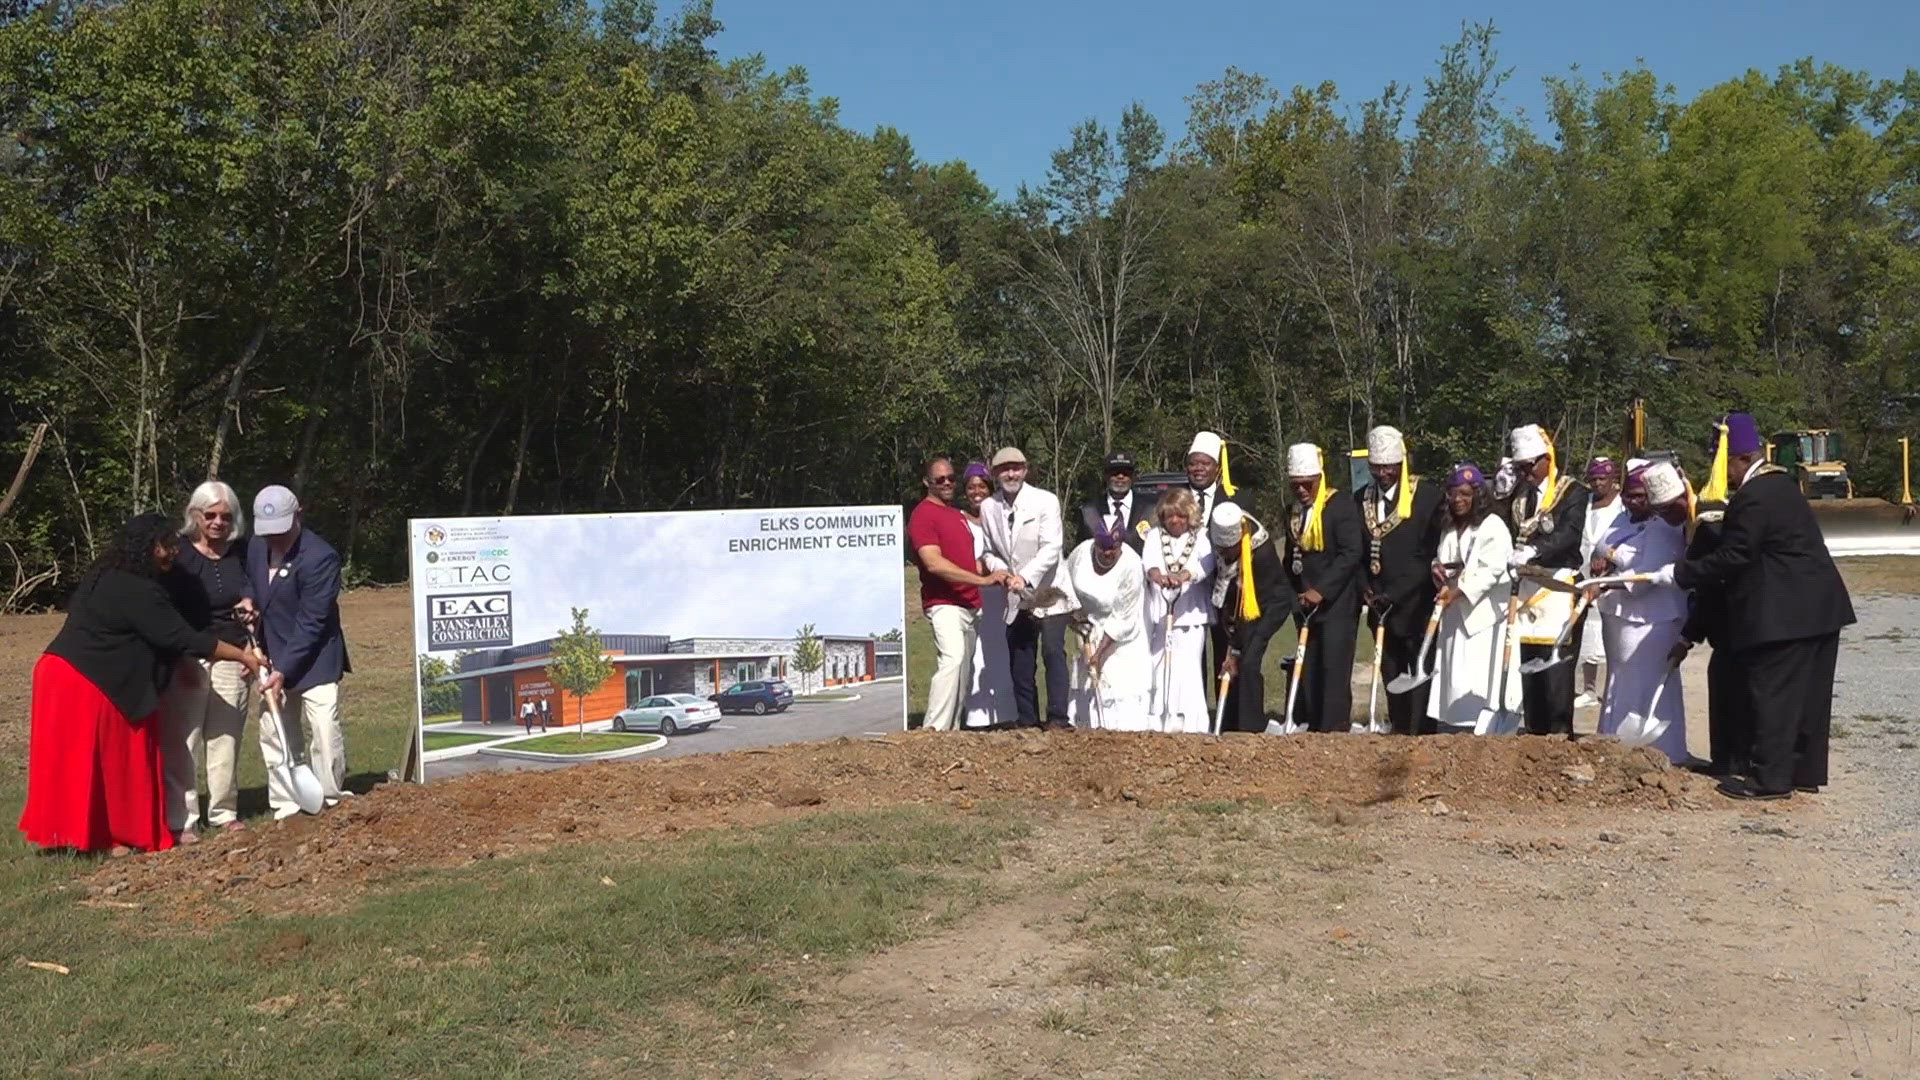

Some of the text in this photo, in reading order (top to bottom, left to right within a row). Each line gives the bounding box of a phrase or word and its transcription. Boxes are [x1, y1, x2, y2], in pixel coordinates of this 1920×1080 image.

[760, 514, 896, 532] ELKS COMMUNITY
[728, 533, 897, 552] ENRICHMENT CENTER
[450, 564, 511, 583] TAC
[436, 597, 506, 616] EAC
[432, 616, 509, 632] EVANS-AILEY
[432, 627, 510, 642] CONSTRUCTION
